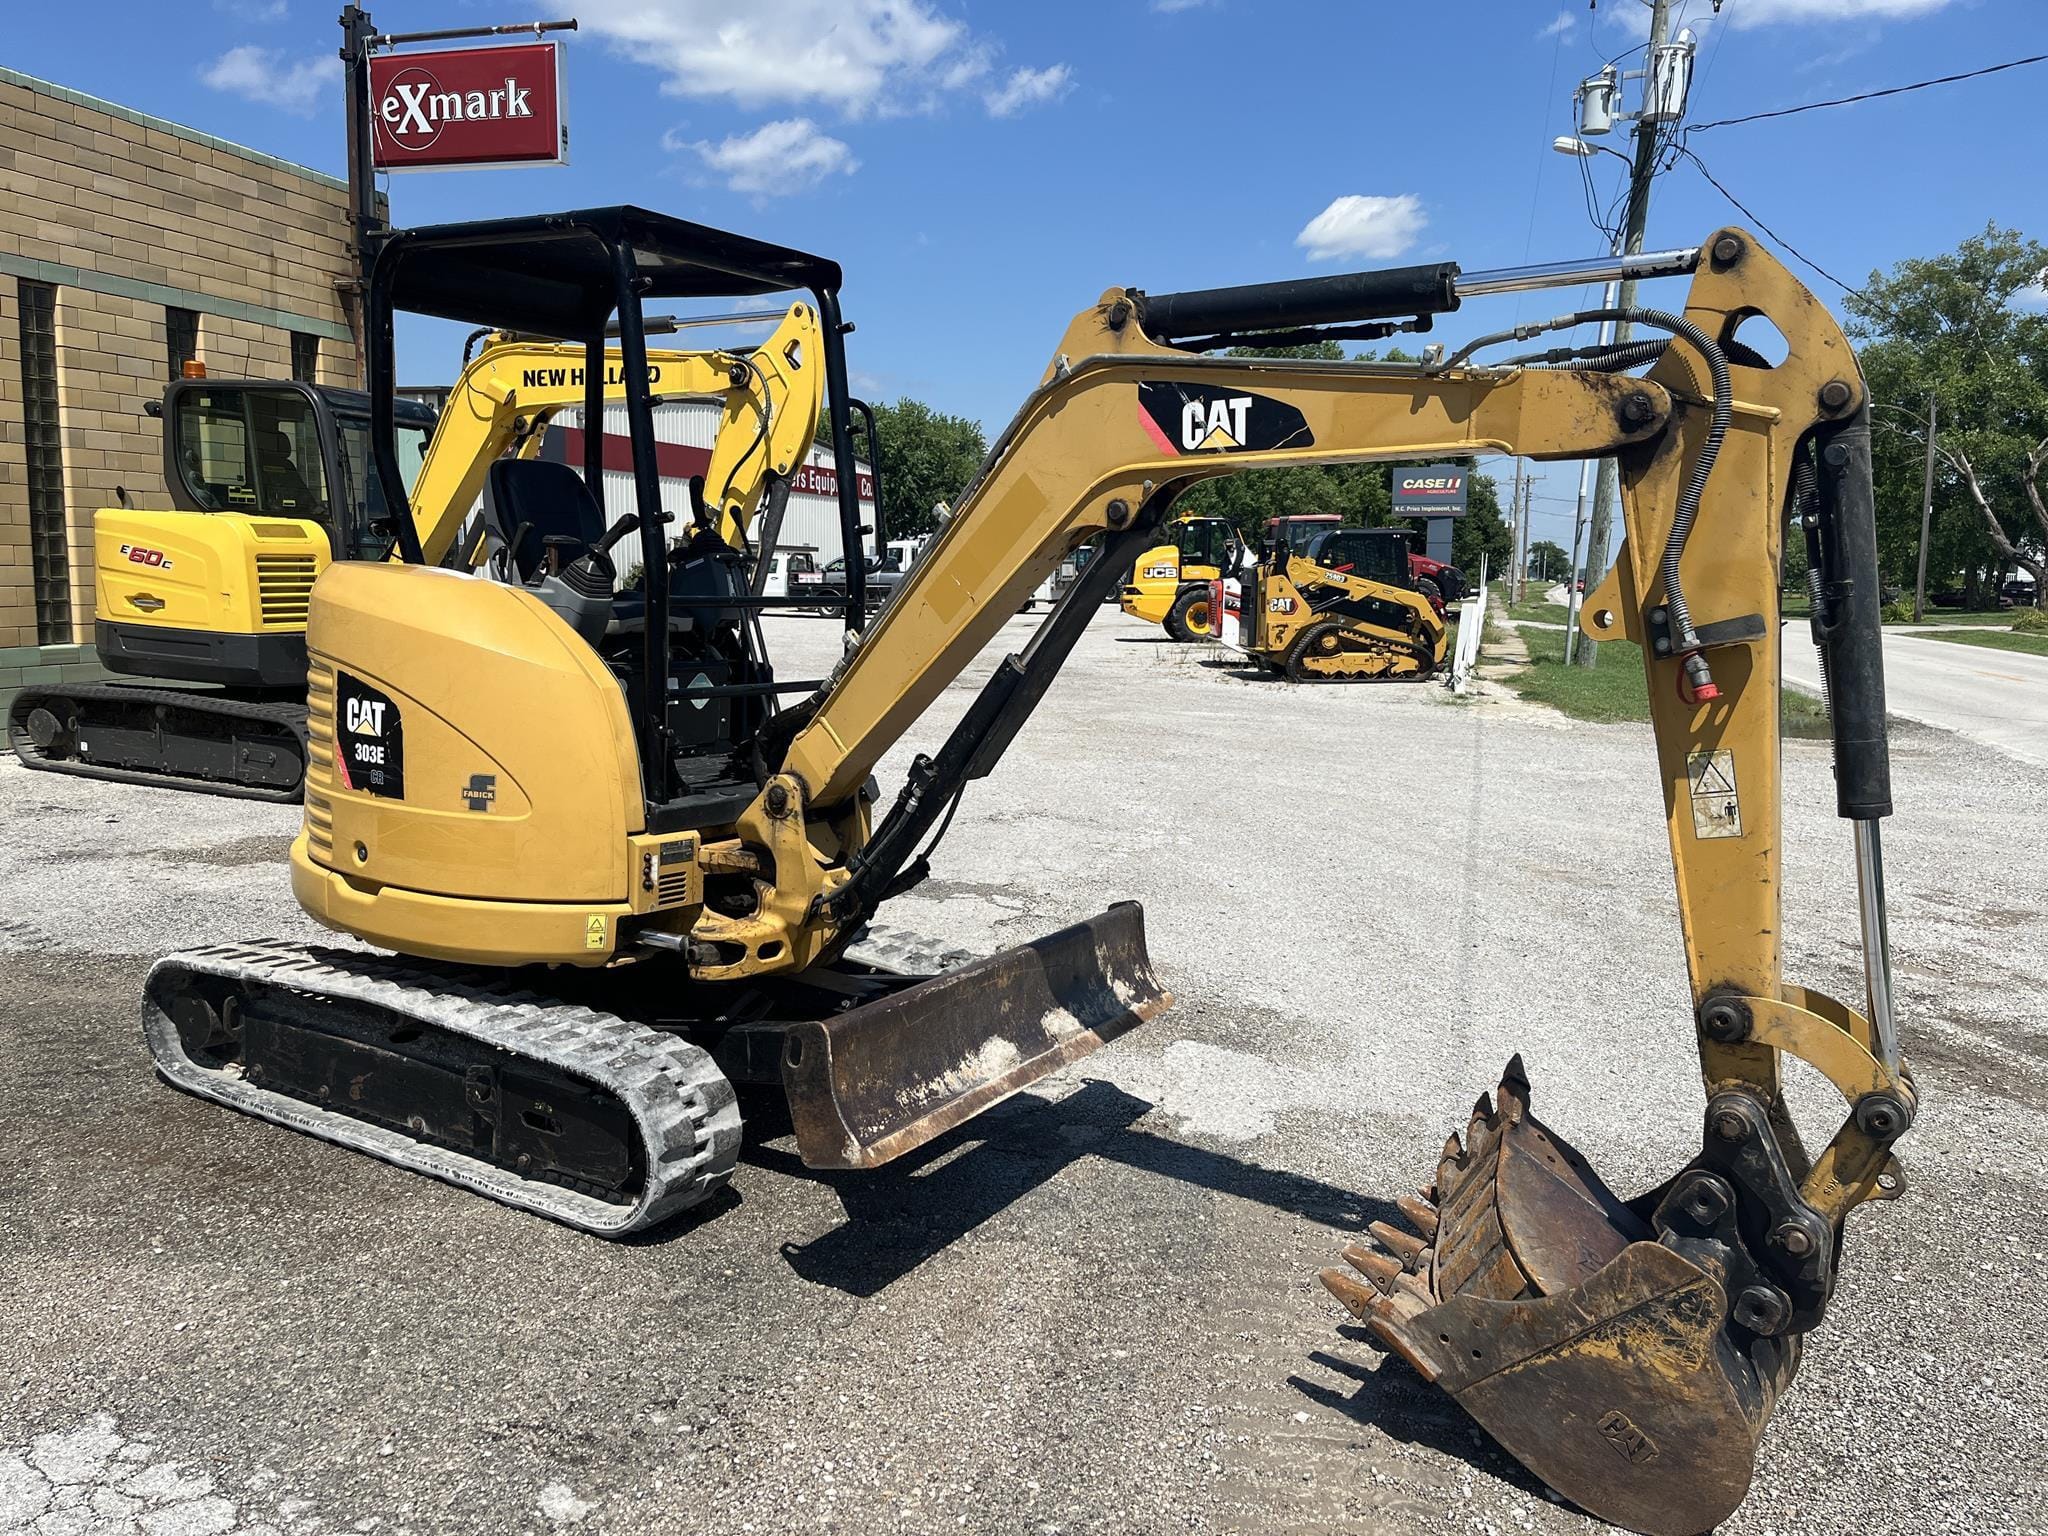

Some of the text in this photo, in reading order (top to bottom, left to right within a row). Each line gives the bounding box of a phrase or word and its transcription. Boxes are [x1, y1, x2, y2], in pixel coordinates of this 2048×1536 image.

[381, 78, 532, 135] eXmark
[523, 369, 565, 387] NEW
[1182, 396, 1252, 450] CAT
[861, 478, 873, 496] Co.
[1402, 479, 1446, 489] CASE
[1143, 568, 1177, 578] JCB
[1270, 598, 1292, 611] CAT
[346, 697, 385, 737] CAT
[355, 743, 384, 764] 303E
[371, 769, 384, 785] CR
[463, 790, 494, 799] FABICK
